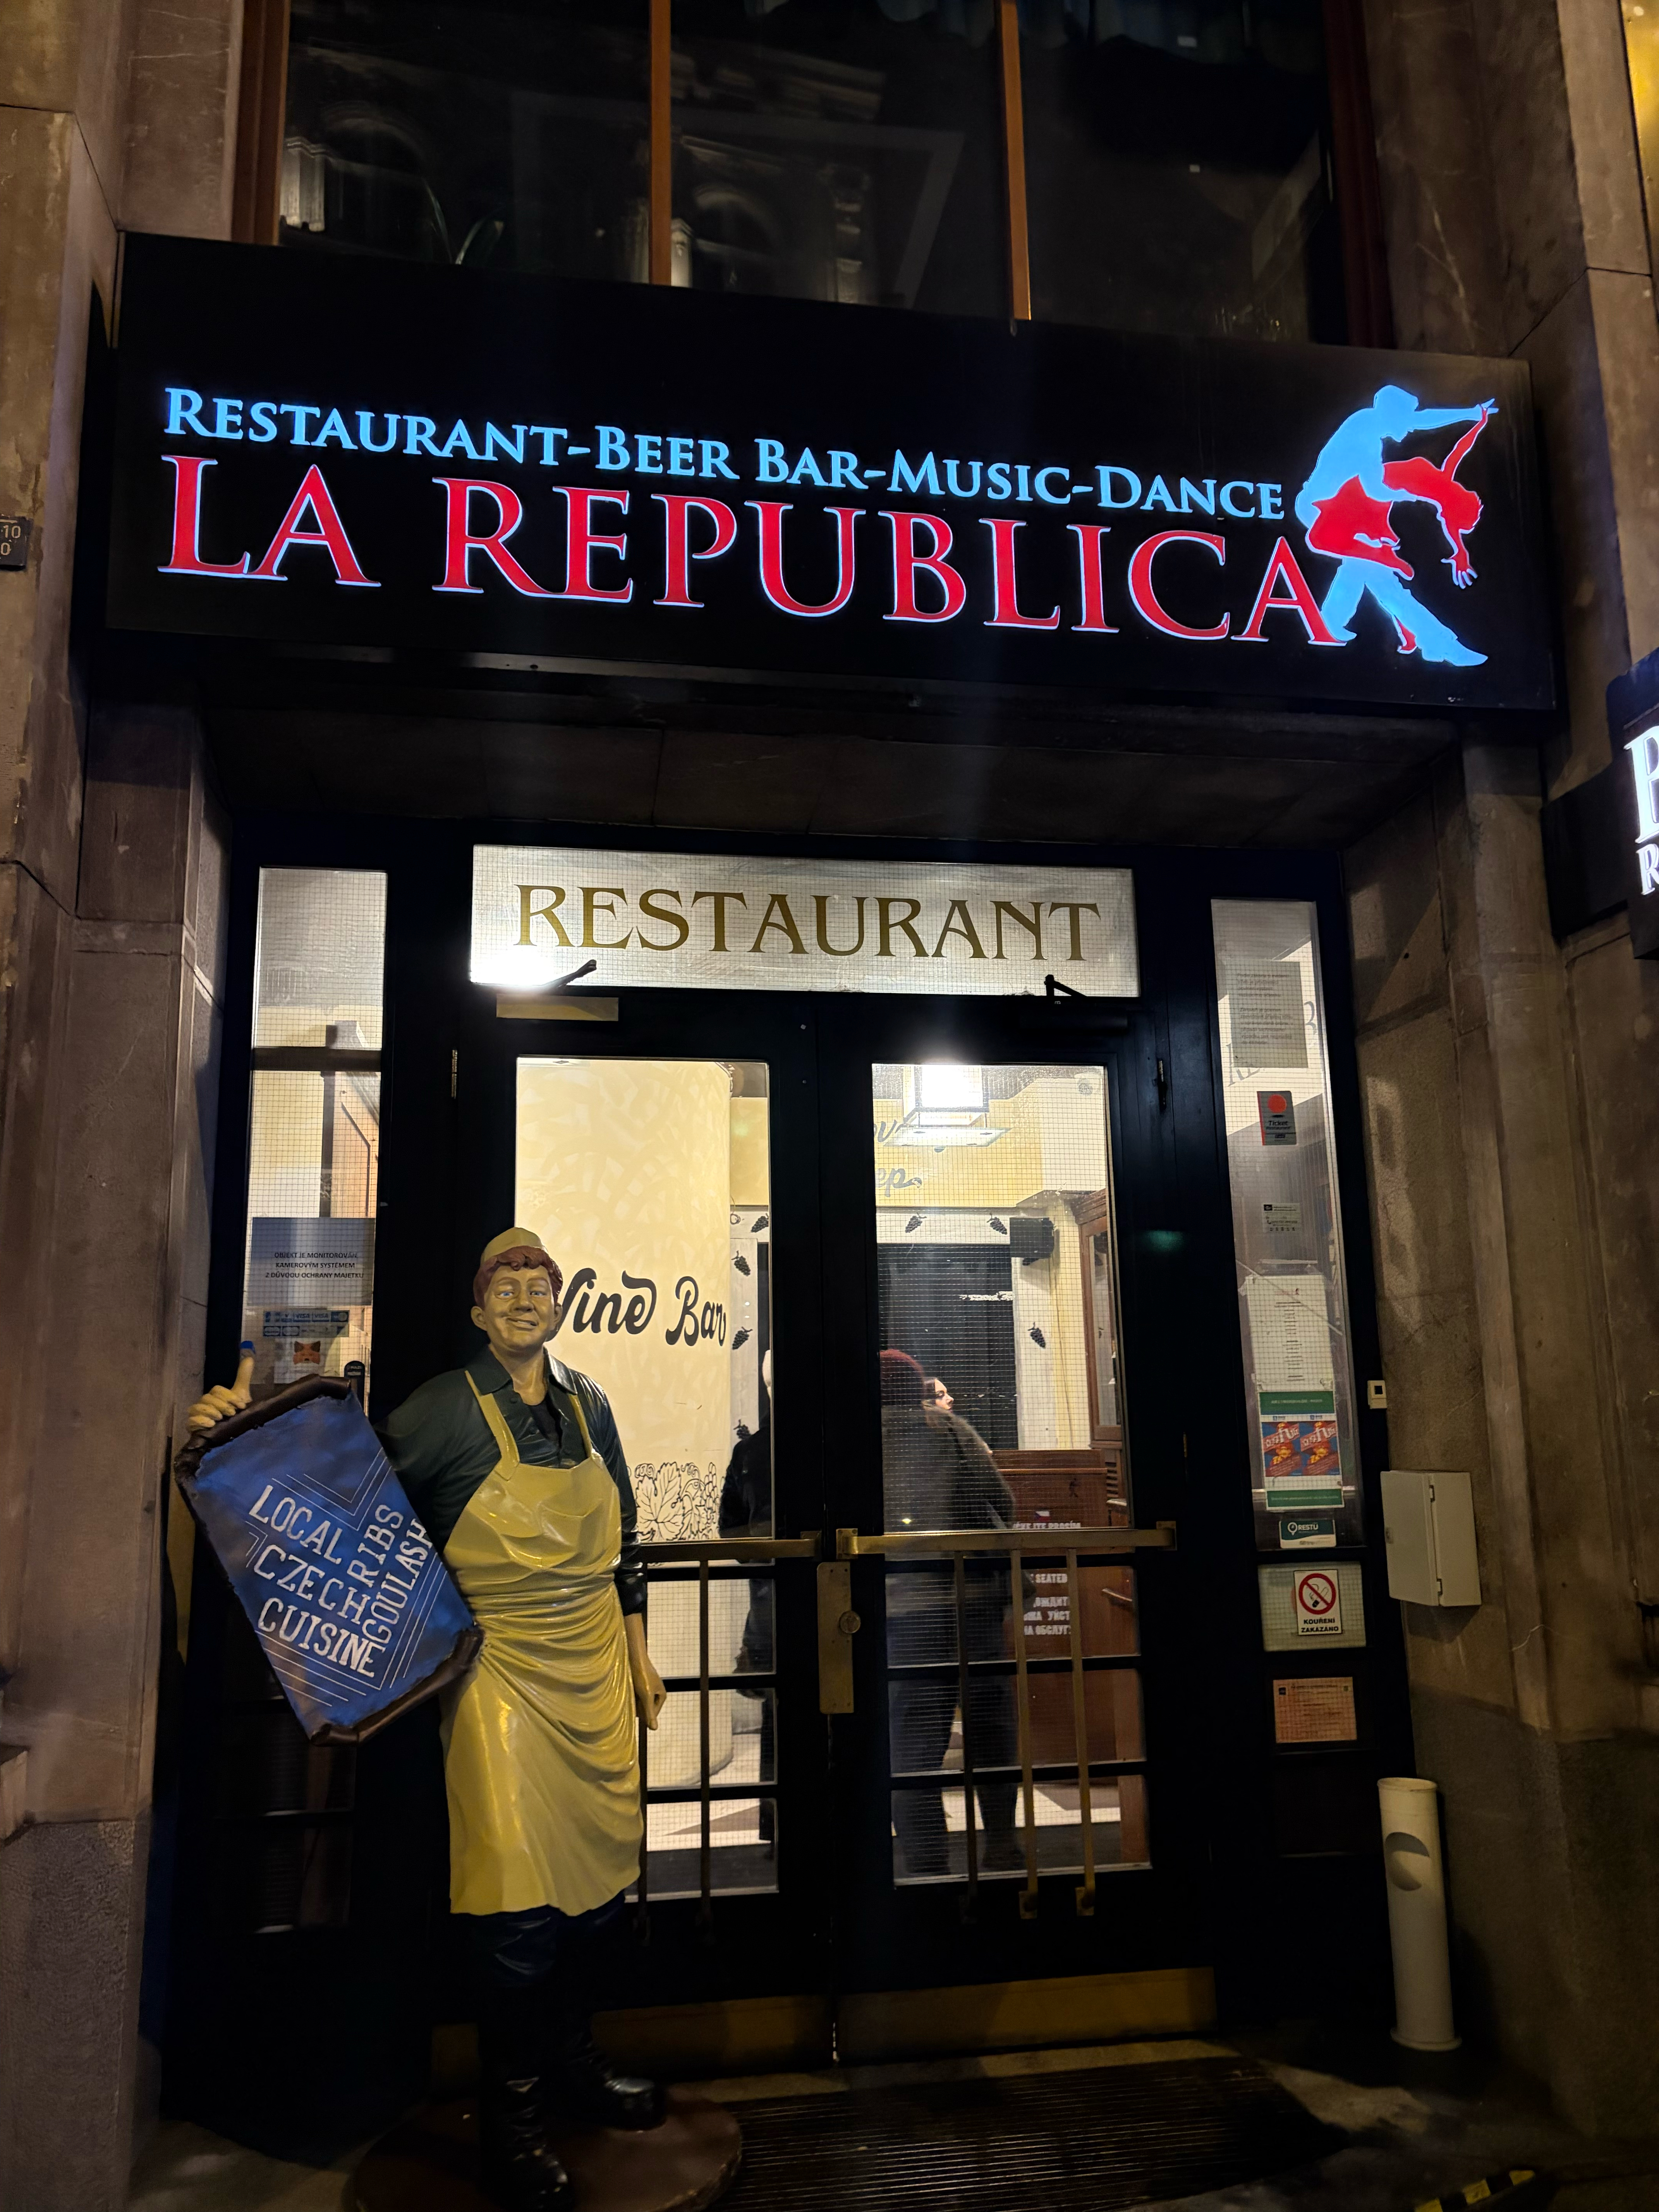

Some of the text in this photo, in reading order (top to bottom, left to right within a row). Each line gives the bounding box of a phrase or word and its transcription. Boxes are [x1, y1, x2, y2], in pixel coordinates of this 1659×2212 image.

[158, 455, 1348, 647] LA REPUBLICA
[513, 884, 1101, 962] RESTAURANT
[665, 1276, 726, 1347] Bar
[249, 1485, 343, 1565] LOCAL
[347, 1504, 404, 1588] RIBS
[254, 1544, 371, 1625] CZECH
[362, 1518, 433, 1644] GOULASH
[258, 1597, 386, 1678] CUISINE
